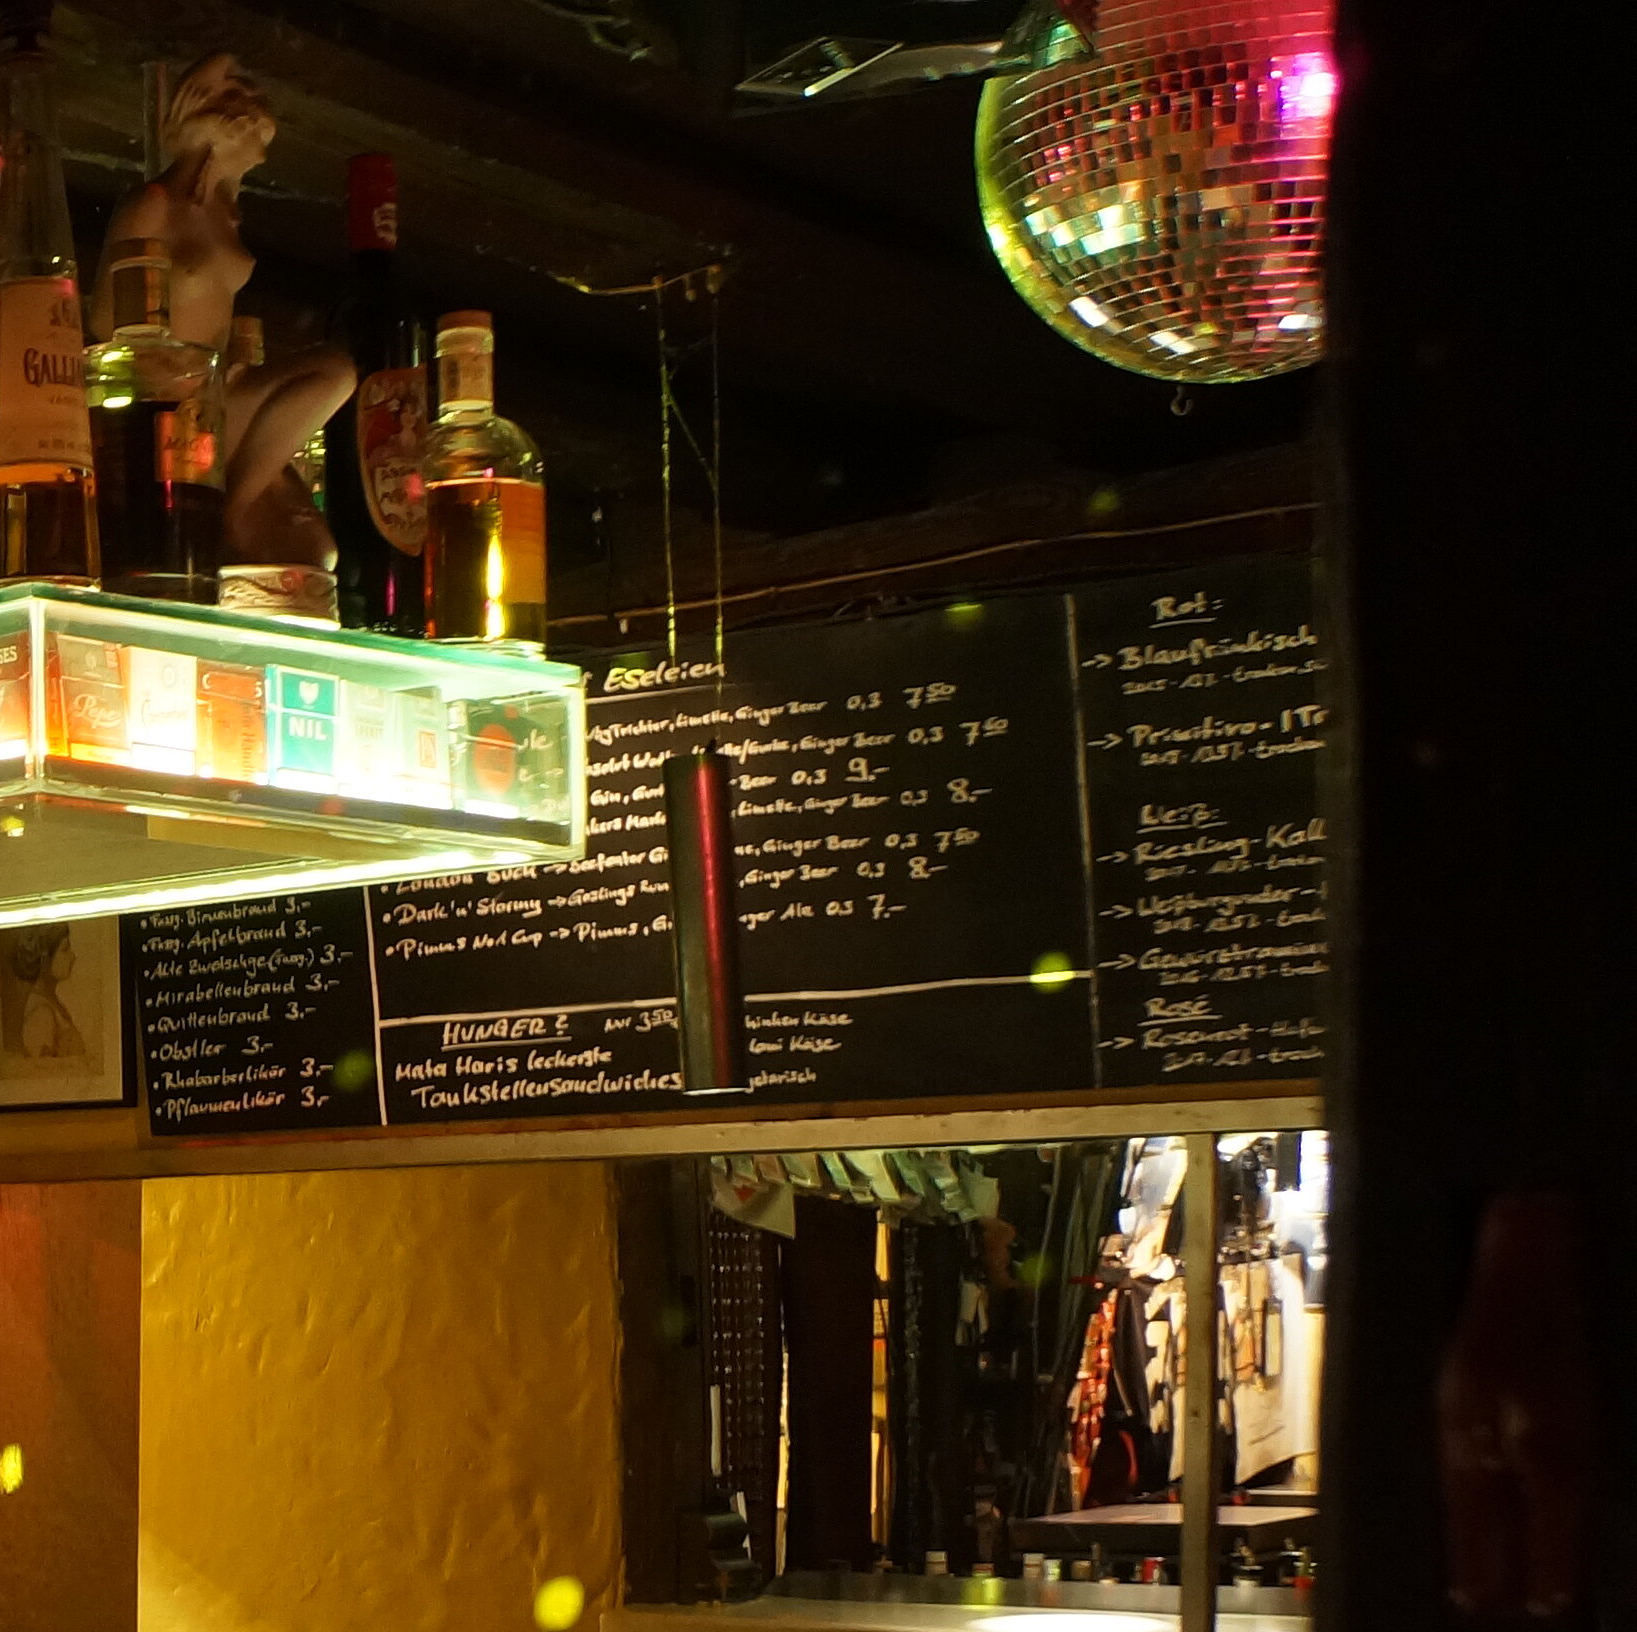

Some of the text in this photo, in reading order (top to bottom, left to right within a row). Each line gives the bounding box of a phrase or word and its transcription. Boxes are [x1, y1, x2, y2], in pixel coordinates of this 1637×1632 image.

[73, 692, 123, 729] Pepe
[288, 715, 327, 741] NIL
[394, 901, 449, 926] Dark
[187, 920, 287, 954] Apfelbrand
[155, 975, 296, 1008] Mirabellenbrand
[156, 1002, 271, 1034] Quittenbrand
[442, 1016, 547, 1046] HUNGER
[744, 1010, 800, 1030] hinken
[394, 1057, 448, 1082] Mata
[454, 1055, 520, 1077] Haris
